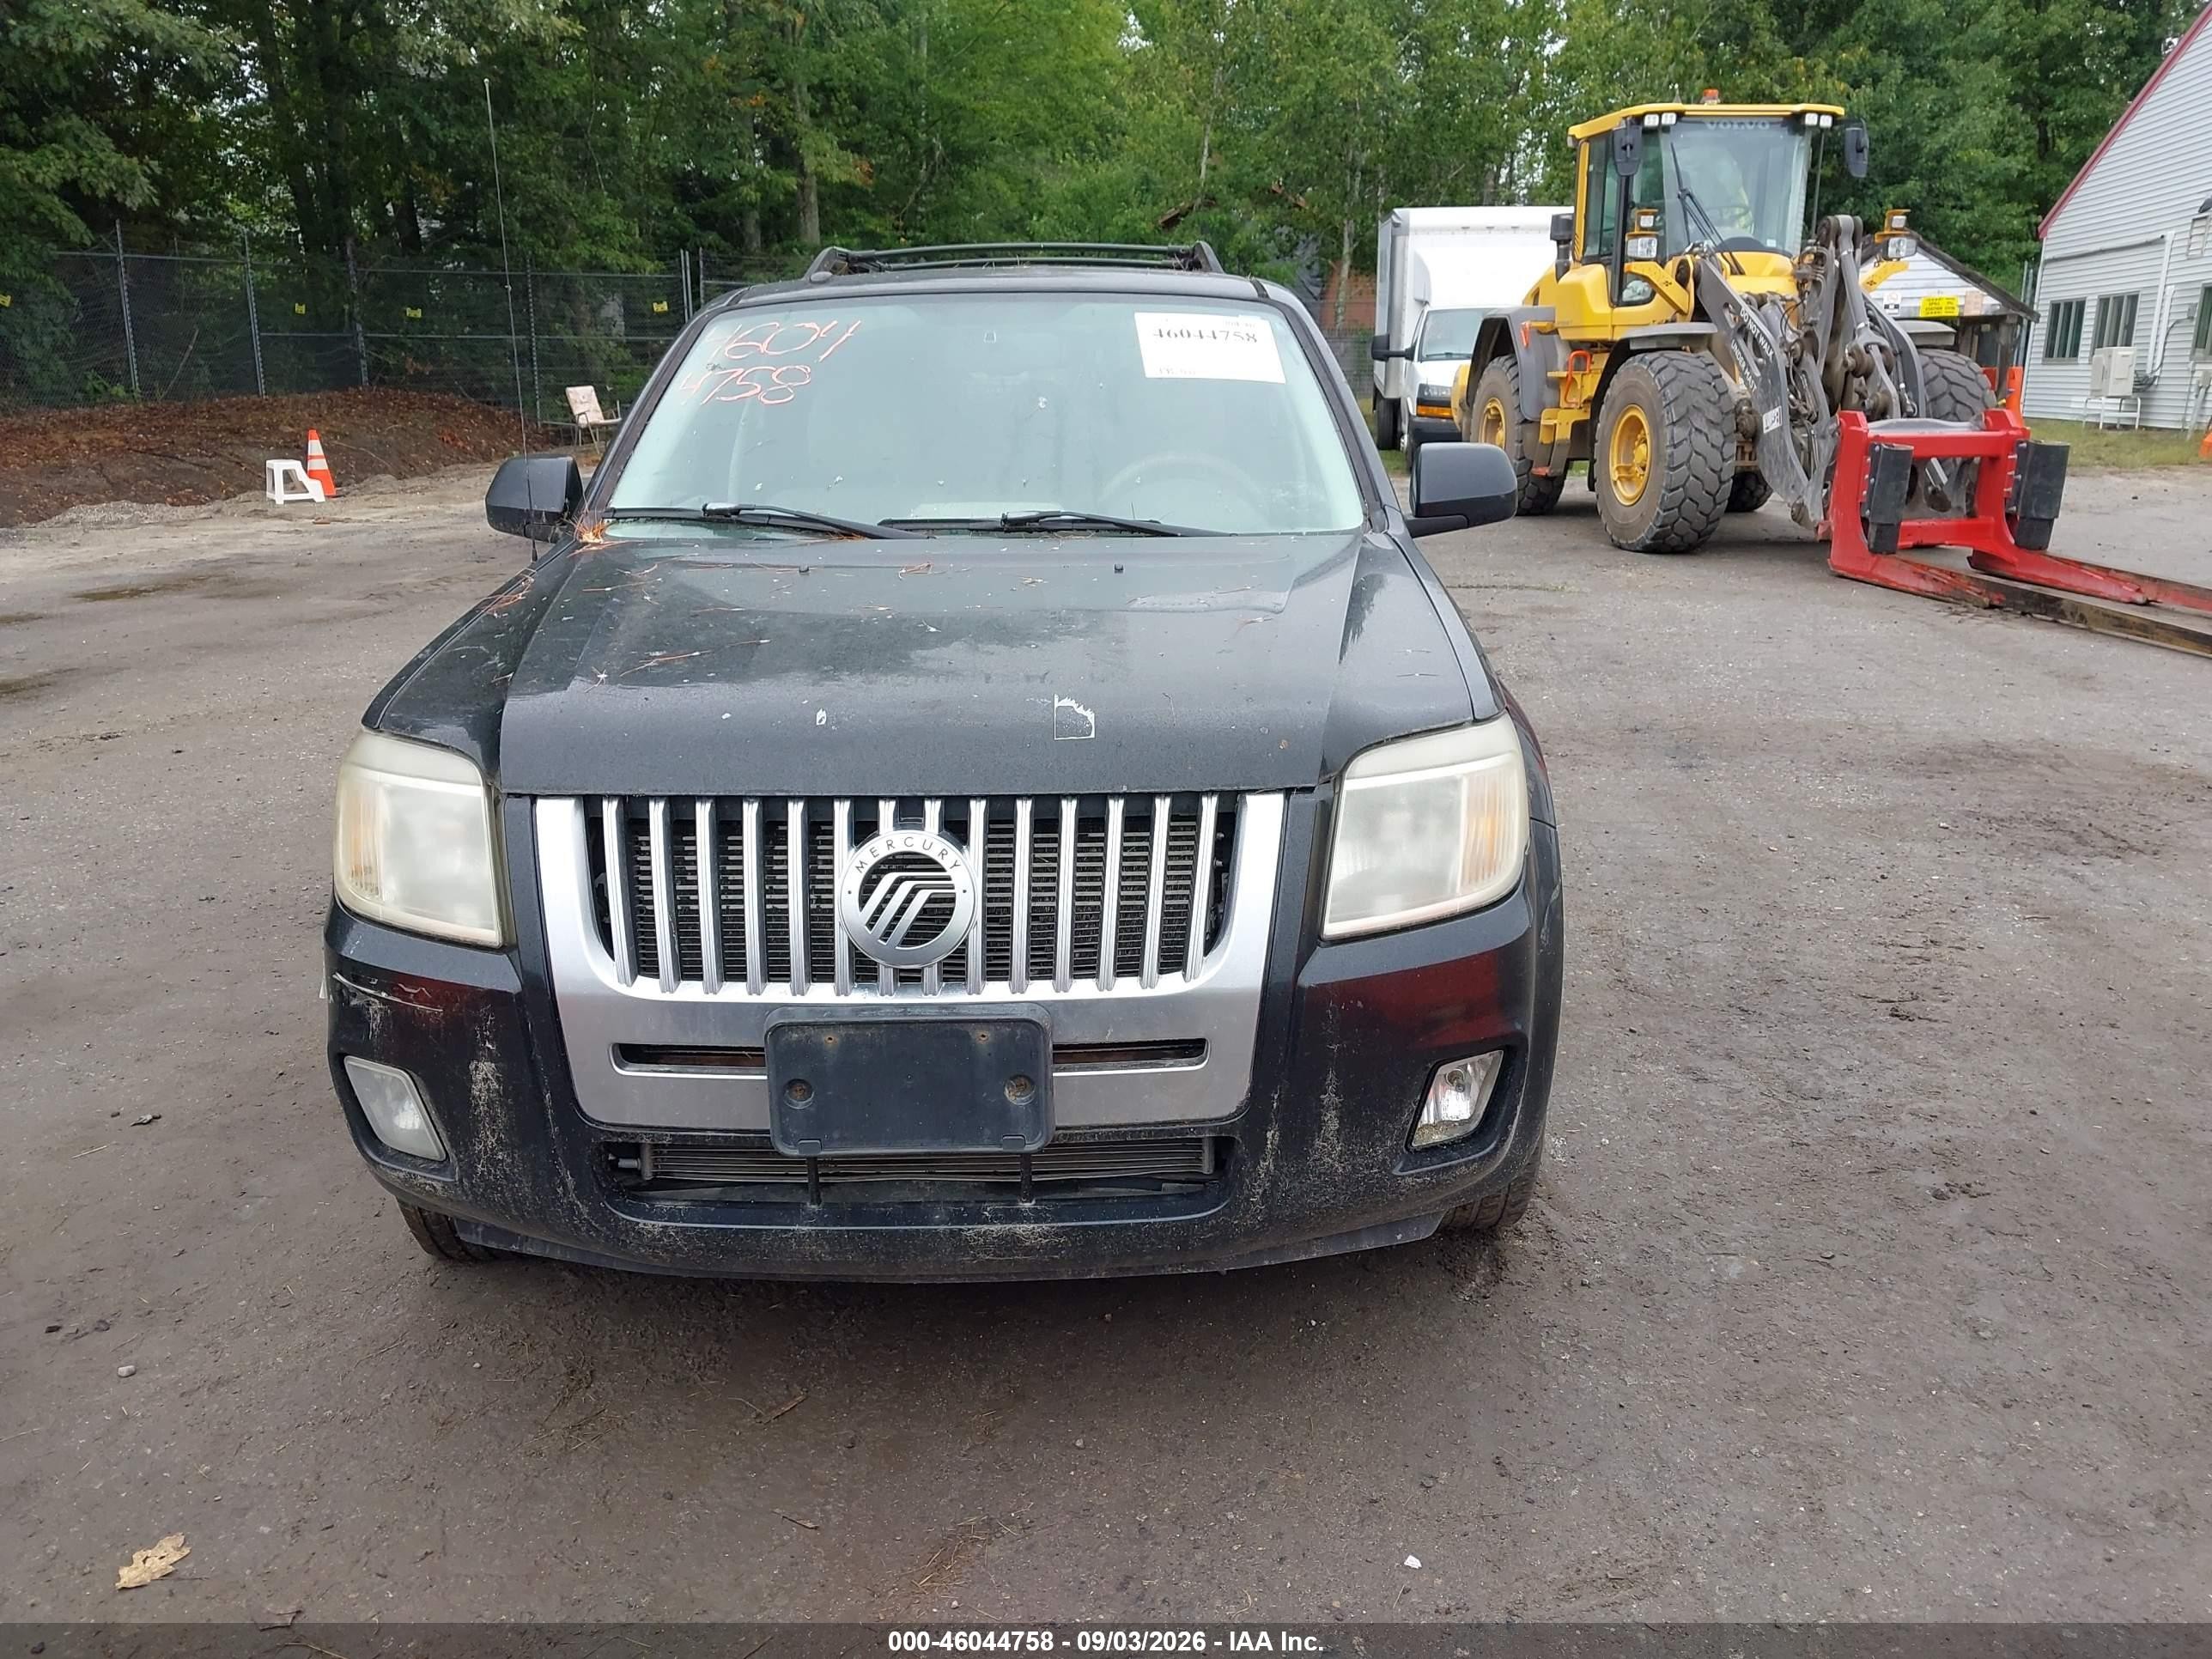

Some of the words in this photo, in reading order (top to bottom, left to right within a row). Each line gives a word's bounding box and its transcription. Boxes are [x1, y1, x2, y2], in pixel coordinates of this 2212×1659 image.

[1152, 328, 1257, 343] 46044758
[1740, 307, 1749, 323] DO
[1747, 321, 1760, 338] NOT
[1759, 333, 1775, 363] WALK
[1731, 338, 1747, 371] UNDER
[679, 365, 811, 404] 4758
[854, 836, 961, 874] MERCURY
